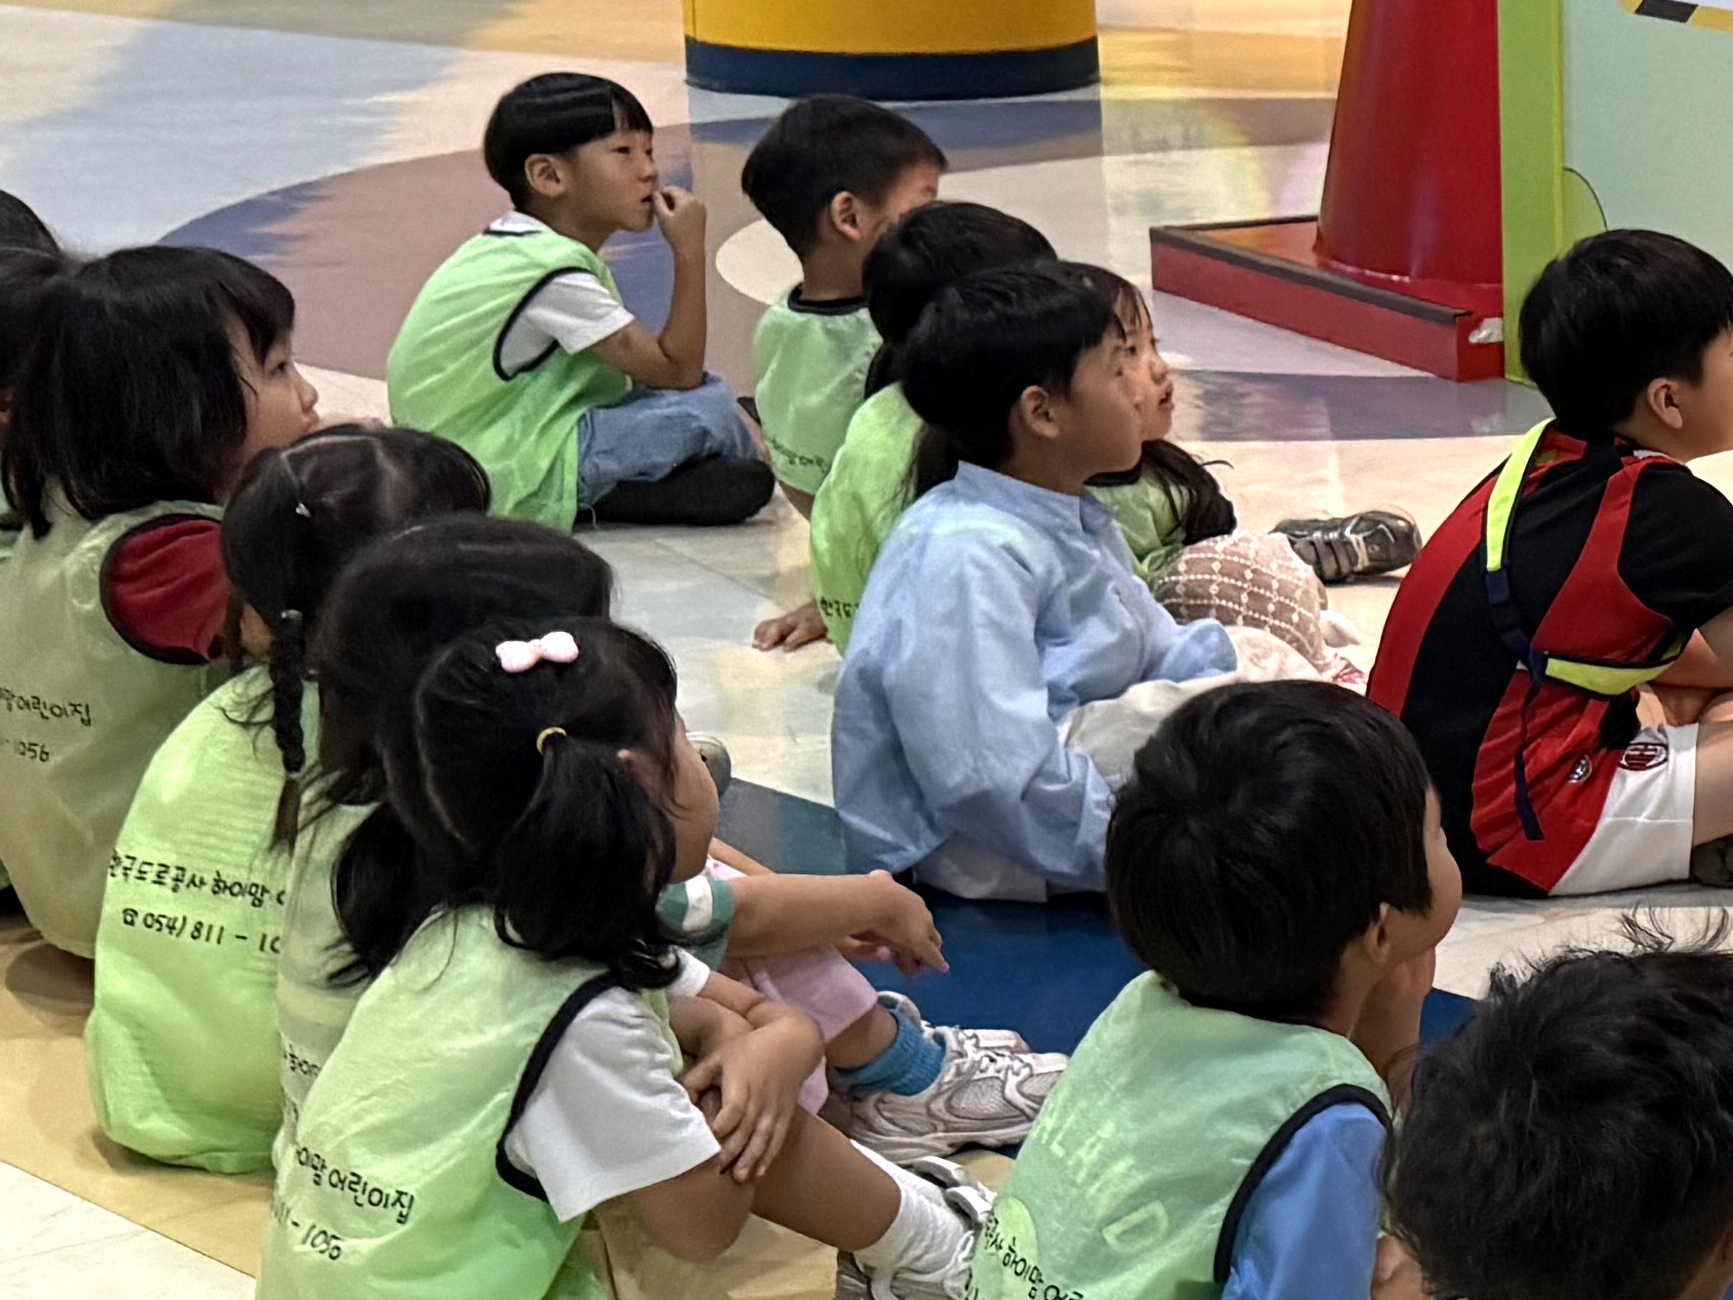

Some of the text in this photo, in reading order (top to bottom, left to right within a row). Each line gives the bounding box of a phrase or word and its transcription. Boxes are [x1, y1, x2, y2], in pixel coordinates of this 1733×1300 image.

[211, 869, 271, 909] 하이맘
[328, 1168, 415, 1226] 어린이집
[1002, 1236, 1043, 1299] 하이맘
